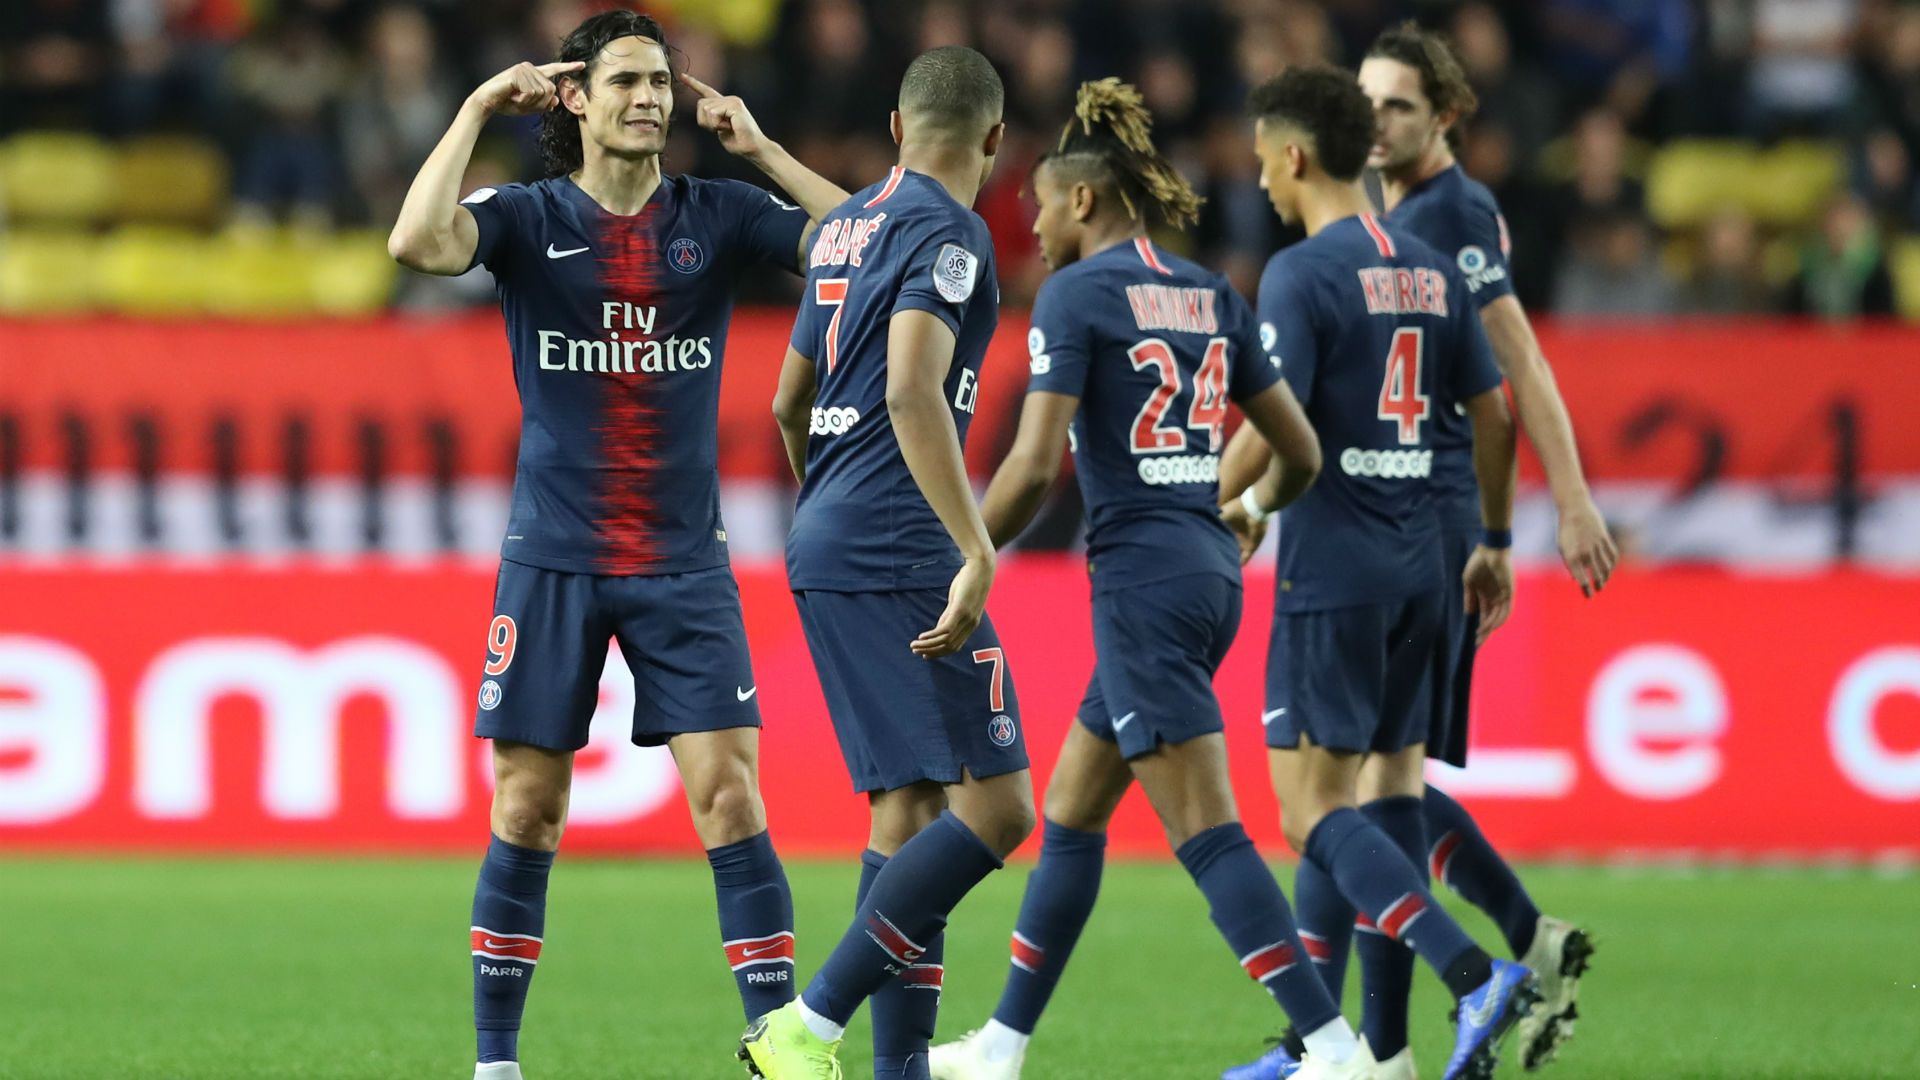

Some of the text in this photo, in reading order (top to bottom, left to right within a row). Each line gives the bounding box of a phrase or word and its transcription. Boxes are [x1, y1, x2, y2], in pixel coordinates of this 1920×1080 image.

[602, 302, 657, 335] Fly
[816, 278, 849, 376] 7
[537, 330, 712, 373] Emirates
[1127, 337, 1228, 454] 24
[1377, 326, 1430, 445] 4
[484, 614, 517, 675] 9
[972, 647, 1004, 712] 7
[480, 964, 523, 977] PARIS
[747, 970, 788, 984] PARIS
